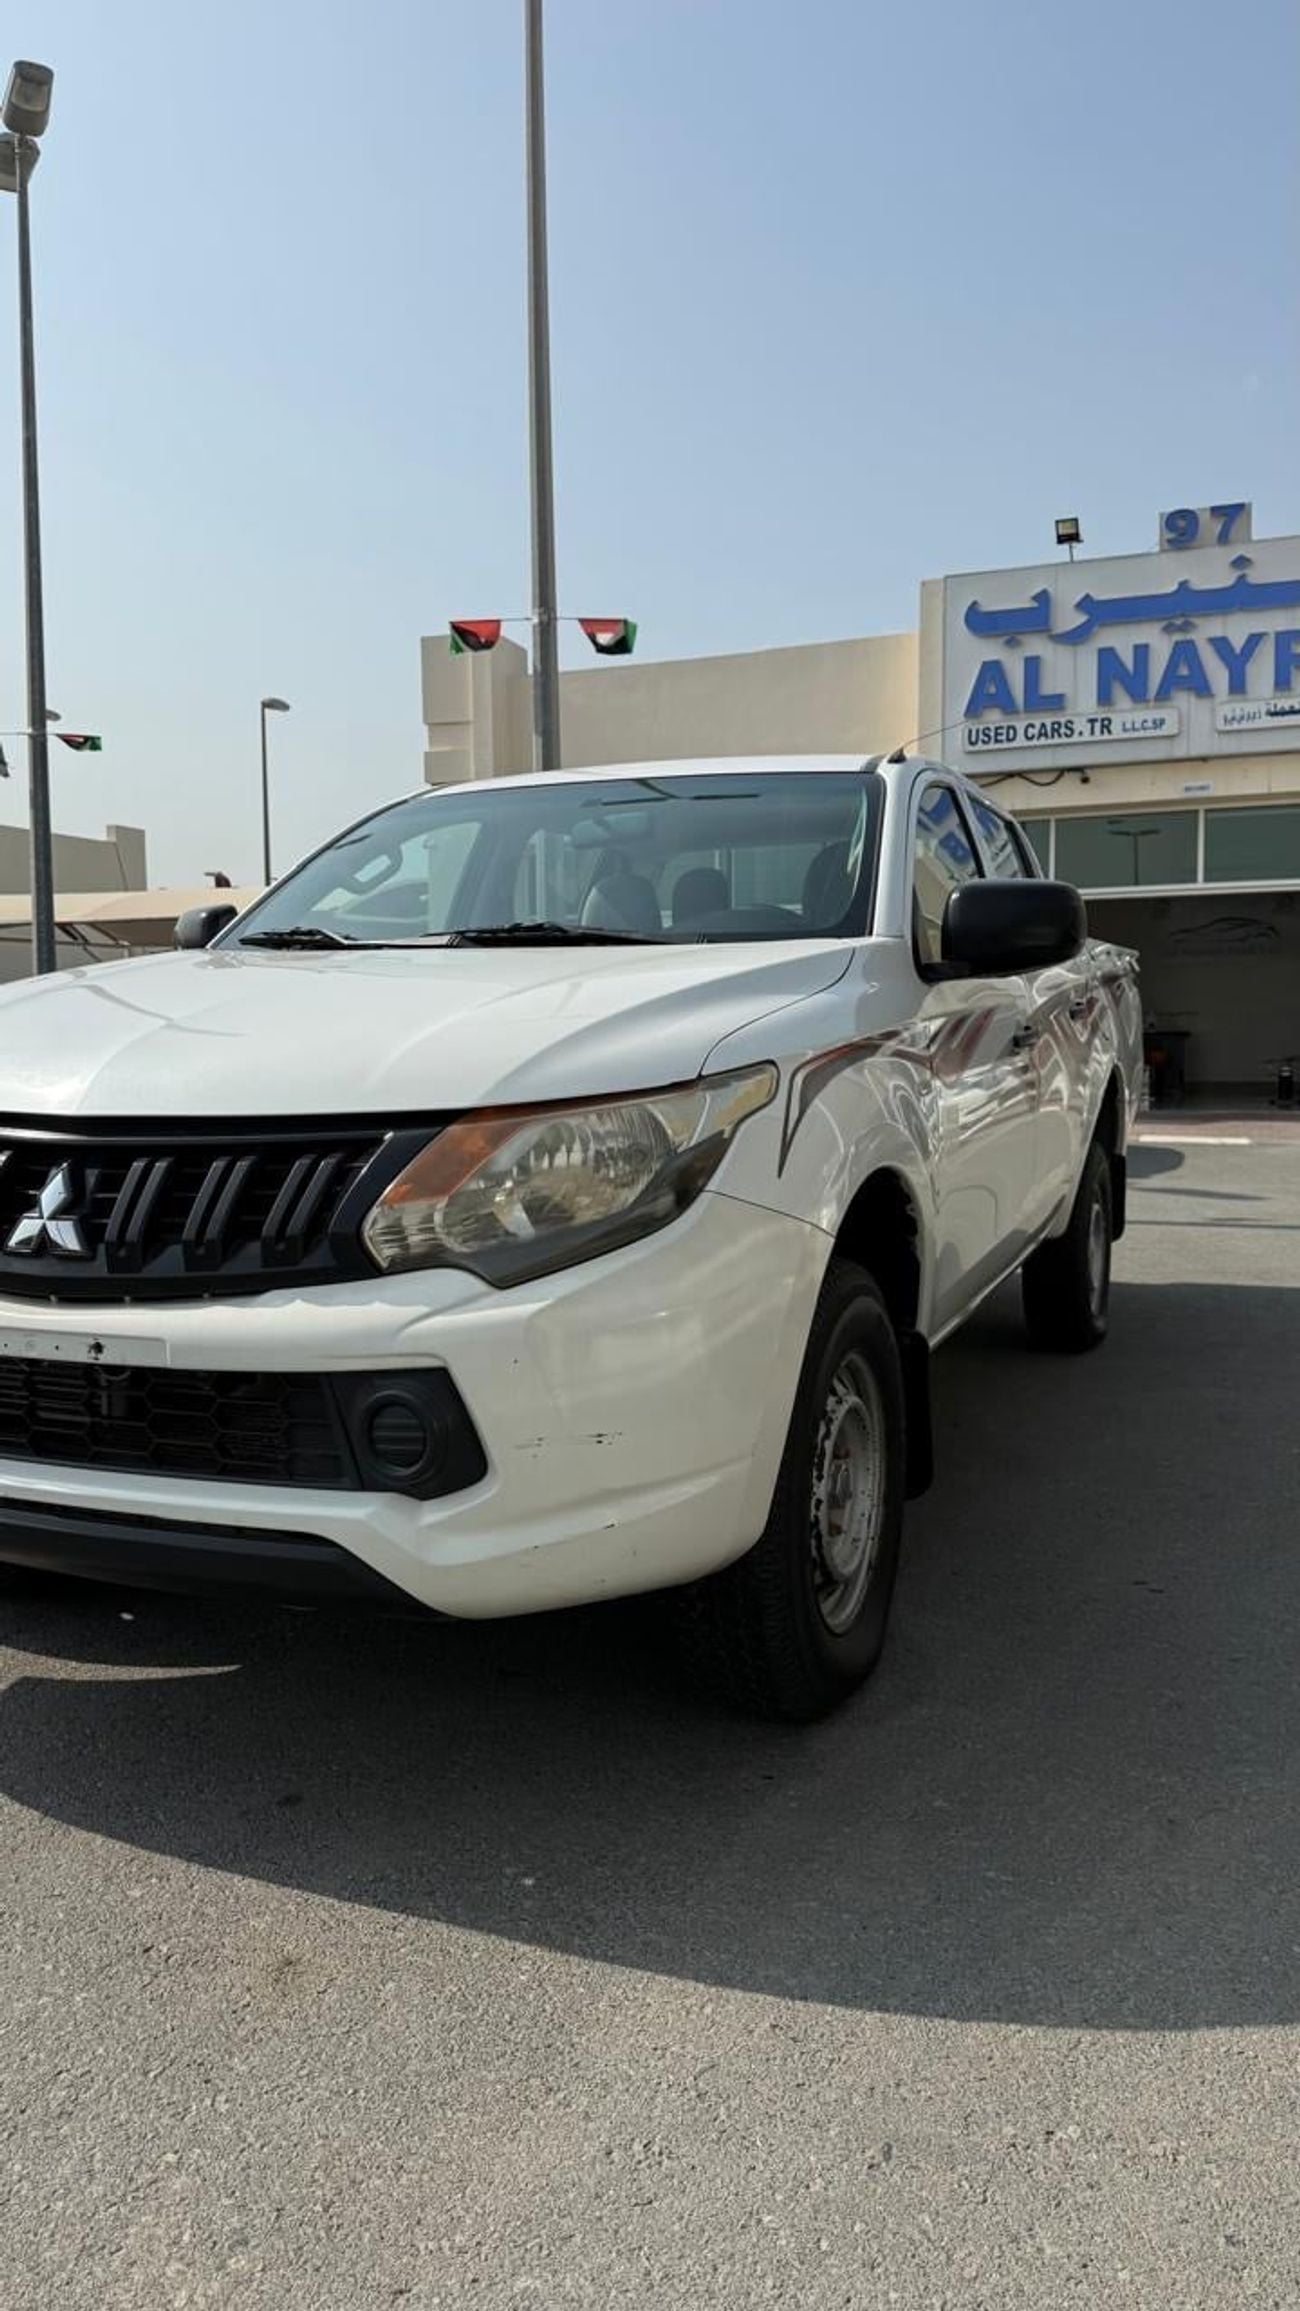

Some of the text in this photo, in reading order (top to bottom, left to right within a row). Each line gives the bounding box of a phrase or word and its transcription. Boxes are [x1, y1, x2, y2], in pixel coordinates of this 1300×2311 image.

[1164, 502, 1246, 548] 97
[964, 553, 1300, 649] نيرب
[964, 655, 1066, 718] AL
[967, 724, 1018, 747] USED
